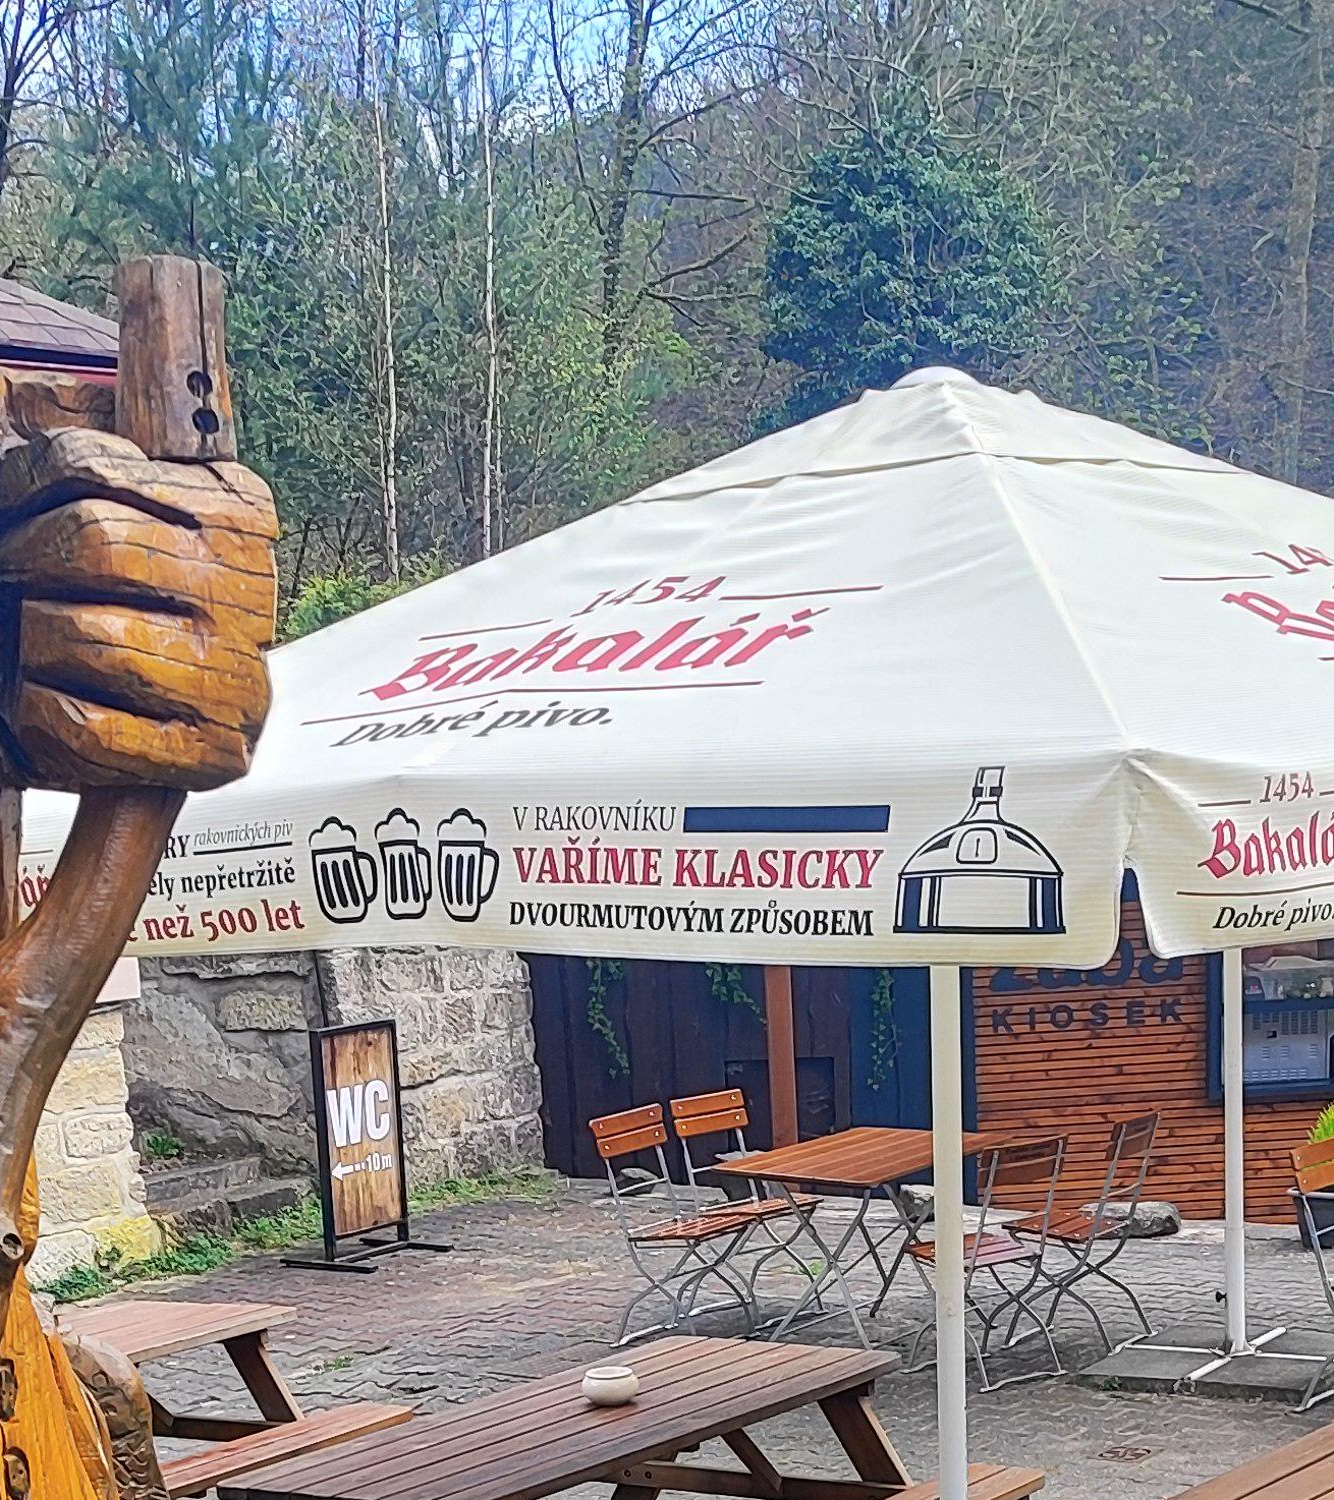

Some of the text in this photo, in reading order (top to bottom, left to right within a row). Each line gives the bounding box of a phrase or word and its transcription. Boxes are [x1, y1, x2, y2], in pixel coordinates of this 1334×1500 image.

[571, 576, 727, 618] 1454
[358, 606, 832, 701] Bakalář
[330, 699, 613, 748] Dobré pivo.
[1259, 770, 1315, 804] 1454
[193, 819, 294, 846] rakovnických piv
[512, 799, 677, 832] V RAKOVNÍKU
[180, 856, 297, 899] nepřetržitě
[512, 835, 885, 889] VAŘÍME KLASICKY
[142, 904, 195, 941] než
[200, 906, 258, 942] 500
[261, 899, 306, 932] let
[509, 900, 874, 937] DVOURMUTOVÝM ZPŮSOBEM
[1213, 900, 1288, 930] Dobré
[990, 995, 1183, 1034] KIOSEK
[326, 1078, 391, 1149] WC
